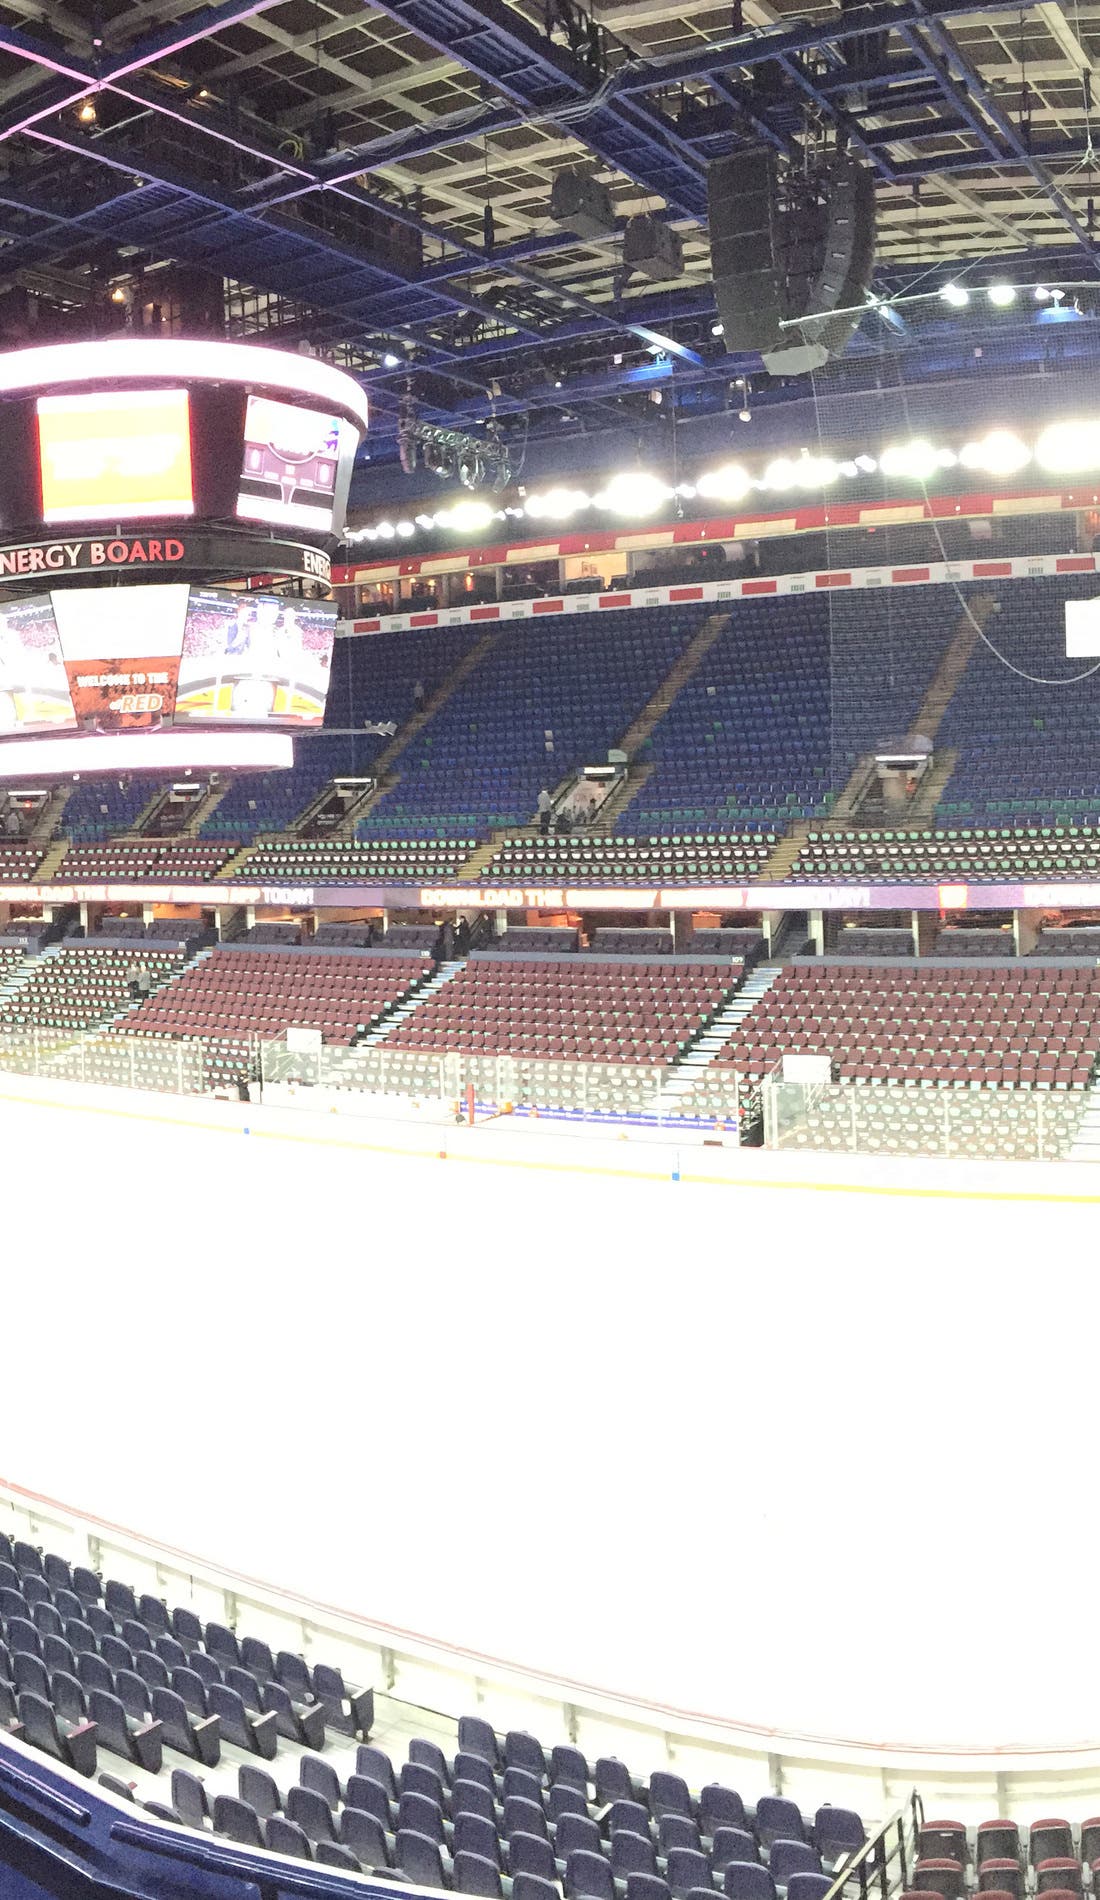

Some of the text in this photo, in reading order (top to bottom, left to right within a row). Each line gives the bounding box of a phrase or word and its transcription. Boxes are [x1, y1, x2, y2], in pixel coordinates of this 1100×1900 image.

[90, 539, 185, 565] BOARD
[77, 672, 169, 688] WELCOME TO THE
[121, 694, 163, 713] RED
[420, 888, 523, 907] DOWNLOAD
[524, 889, 564, 907] THE
